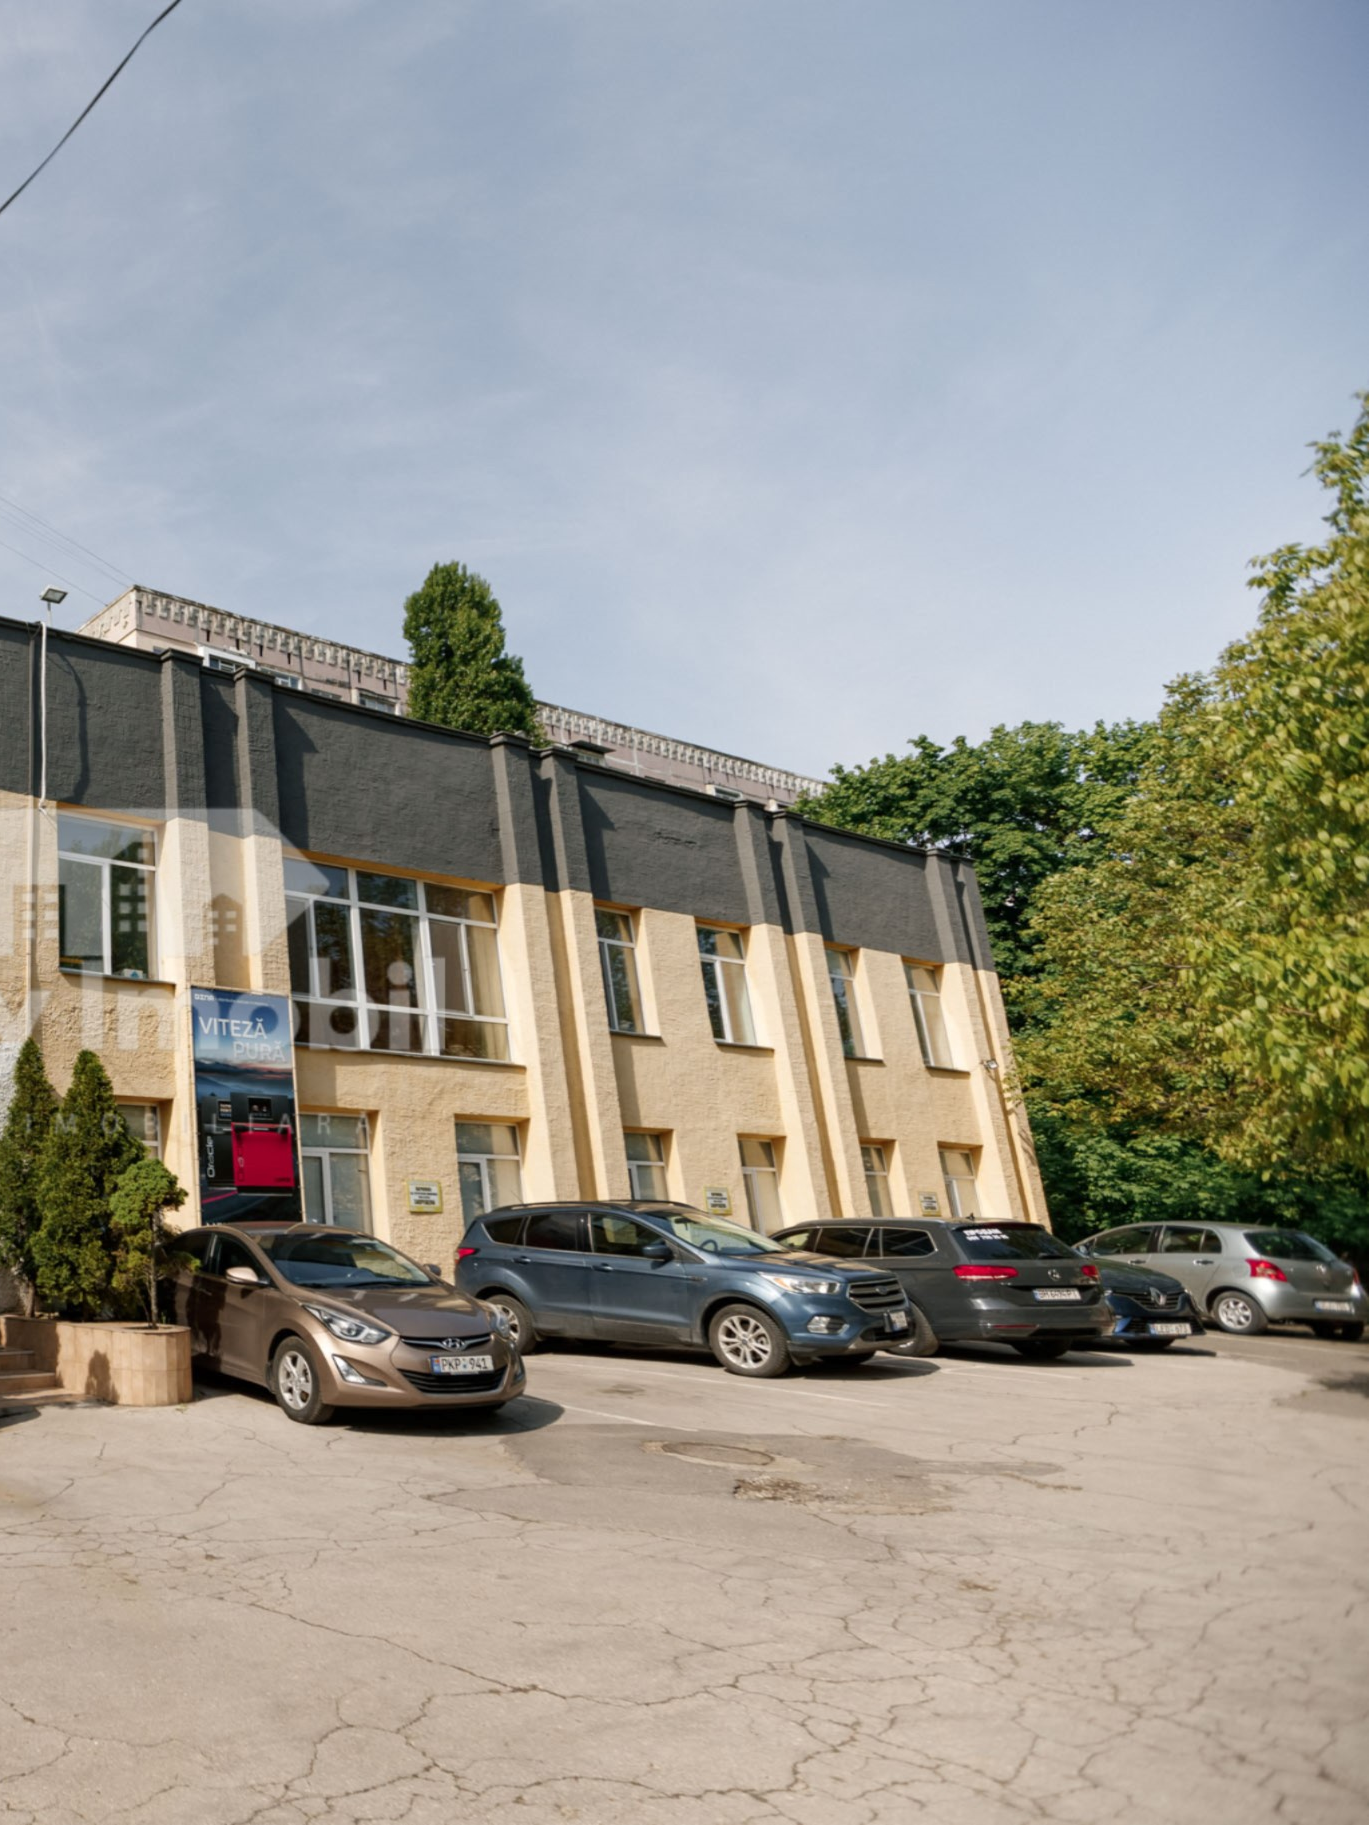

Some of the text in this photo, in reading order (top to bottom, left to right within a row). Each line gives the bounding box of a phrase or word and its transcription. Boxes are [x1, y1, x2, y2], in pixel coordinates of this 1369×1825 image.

[198, 1016, 268, 1040] VITEZĂ
[233, 1040, 286, 1062] PURĂ
[441, 1357, 488, 1370] PKP 941
